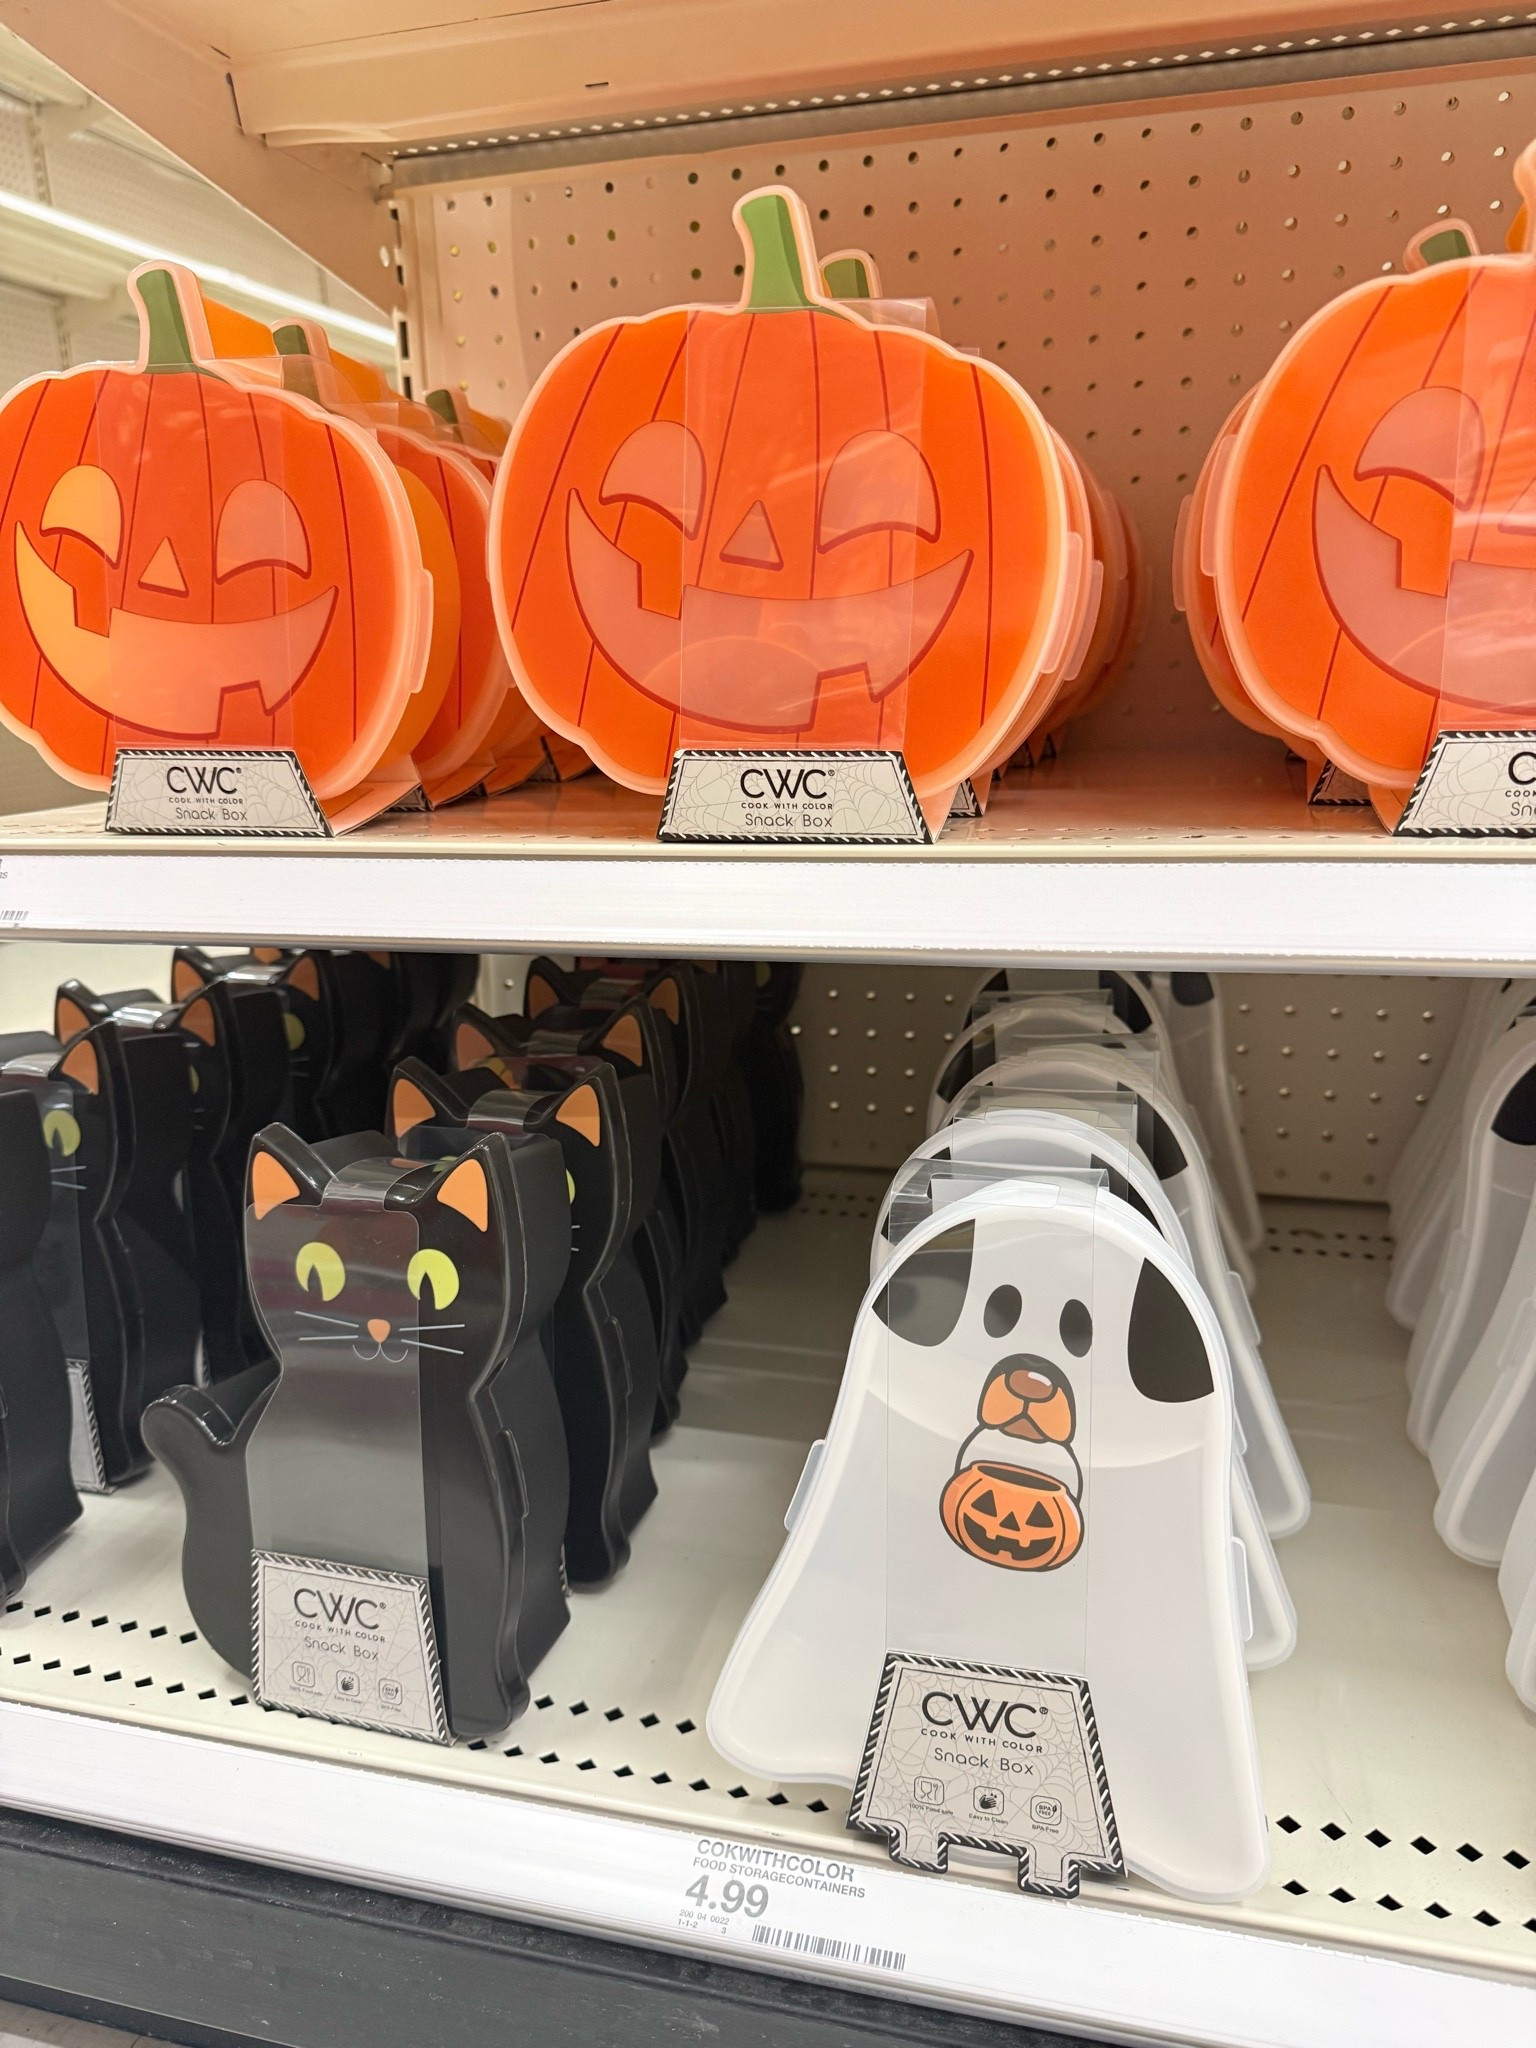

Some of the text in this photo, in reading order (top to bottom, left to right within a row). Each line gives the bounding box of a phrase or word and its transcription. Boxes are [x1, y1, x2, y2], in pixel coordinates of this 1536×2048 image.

[176, 807, 248, 821] Snack Box
[745, 813, 833, 828] Snack Box
[1511, 801, 1536, 816] Sn
[295, 1620, 386, 1643] COOK WITH COLOR
[304, 1636, 379, 1660] Snack Box
[921, 1728, 1043, 1753] COOK WITH COLOR
[934, 1748, 1033, 1775] Snack Box
[968, 1813, 983, 1821] Easy
[697, 1839, 854, 1882] COKWITHCOLOR
[693, 1857, 865, 1898] FOOD STORAGECONTAINERS
[685, 1874, 769, 1918] 4.99
